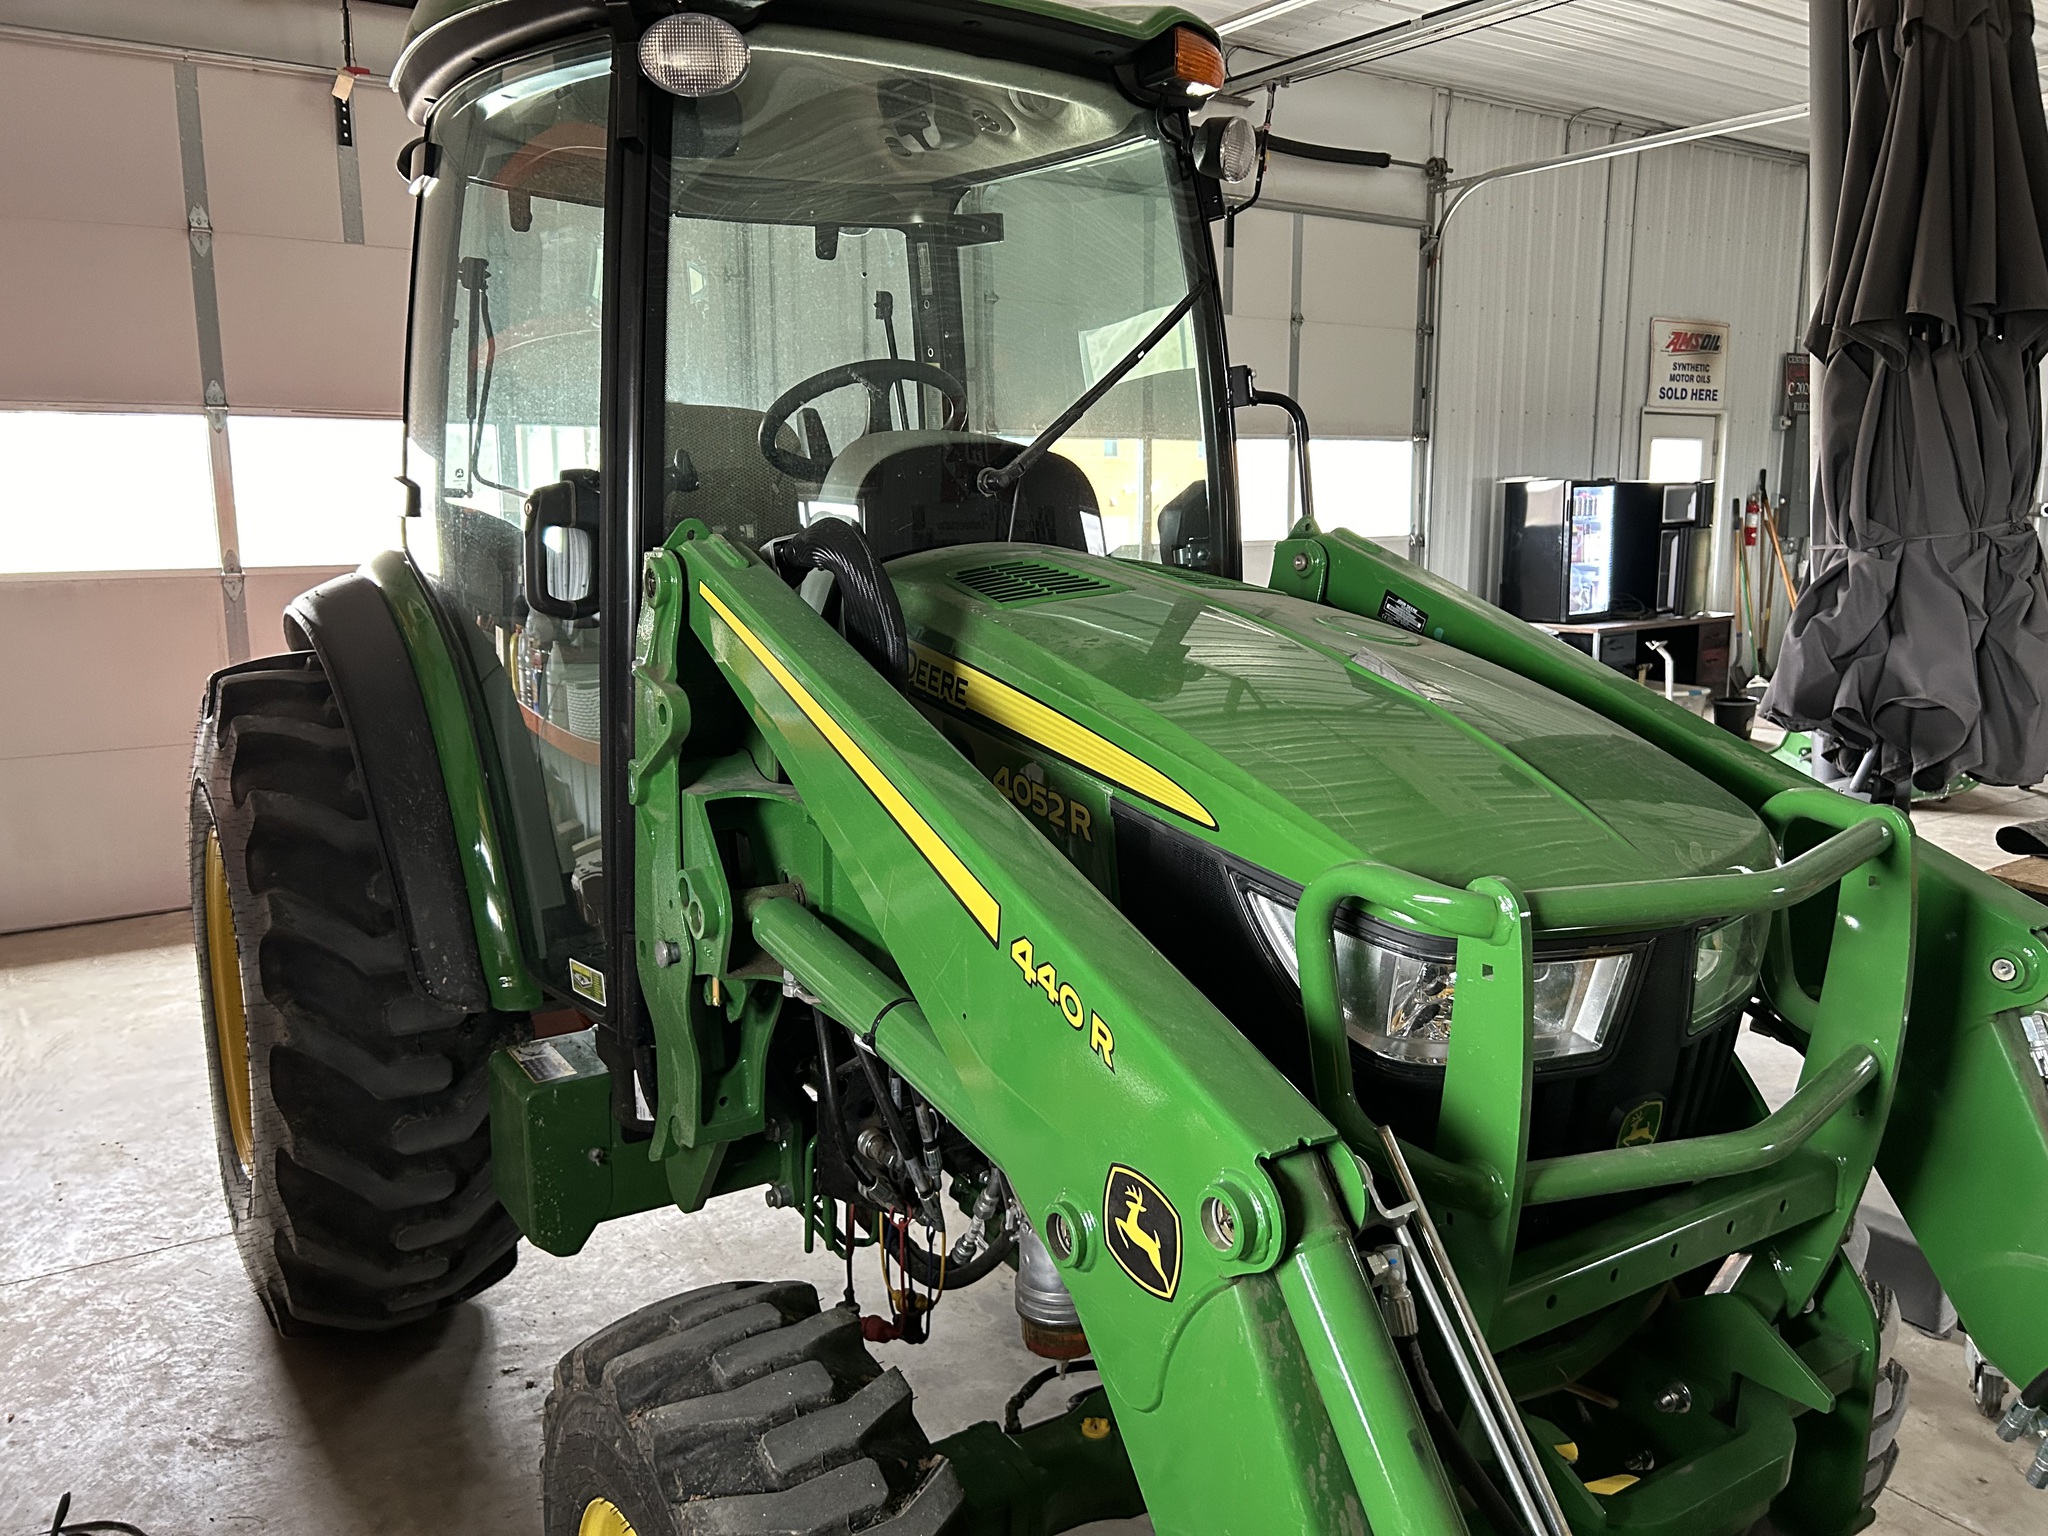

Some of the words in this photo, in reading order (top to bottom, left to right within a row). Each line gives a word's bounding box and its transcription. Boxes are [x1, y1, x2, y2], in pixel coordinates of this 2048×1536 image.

[1665, 331, 1720, 352] AMSOIL
[1672, 362, 1710, 373] SYNTHETIC
[1669, 373, 1694, 383] MOTOR
[1696, 374, 1711, 384] OILS
[1658, 386, 1688, 400] SOLD
[1690, 388, 1718, 401] HERE
